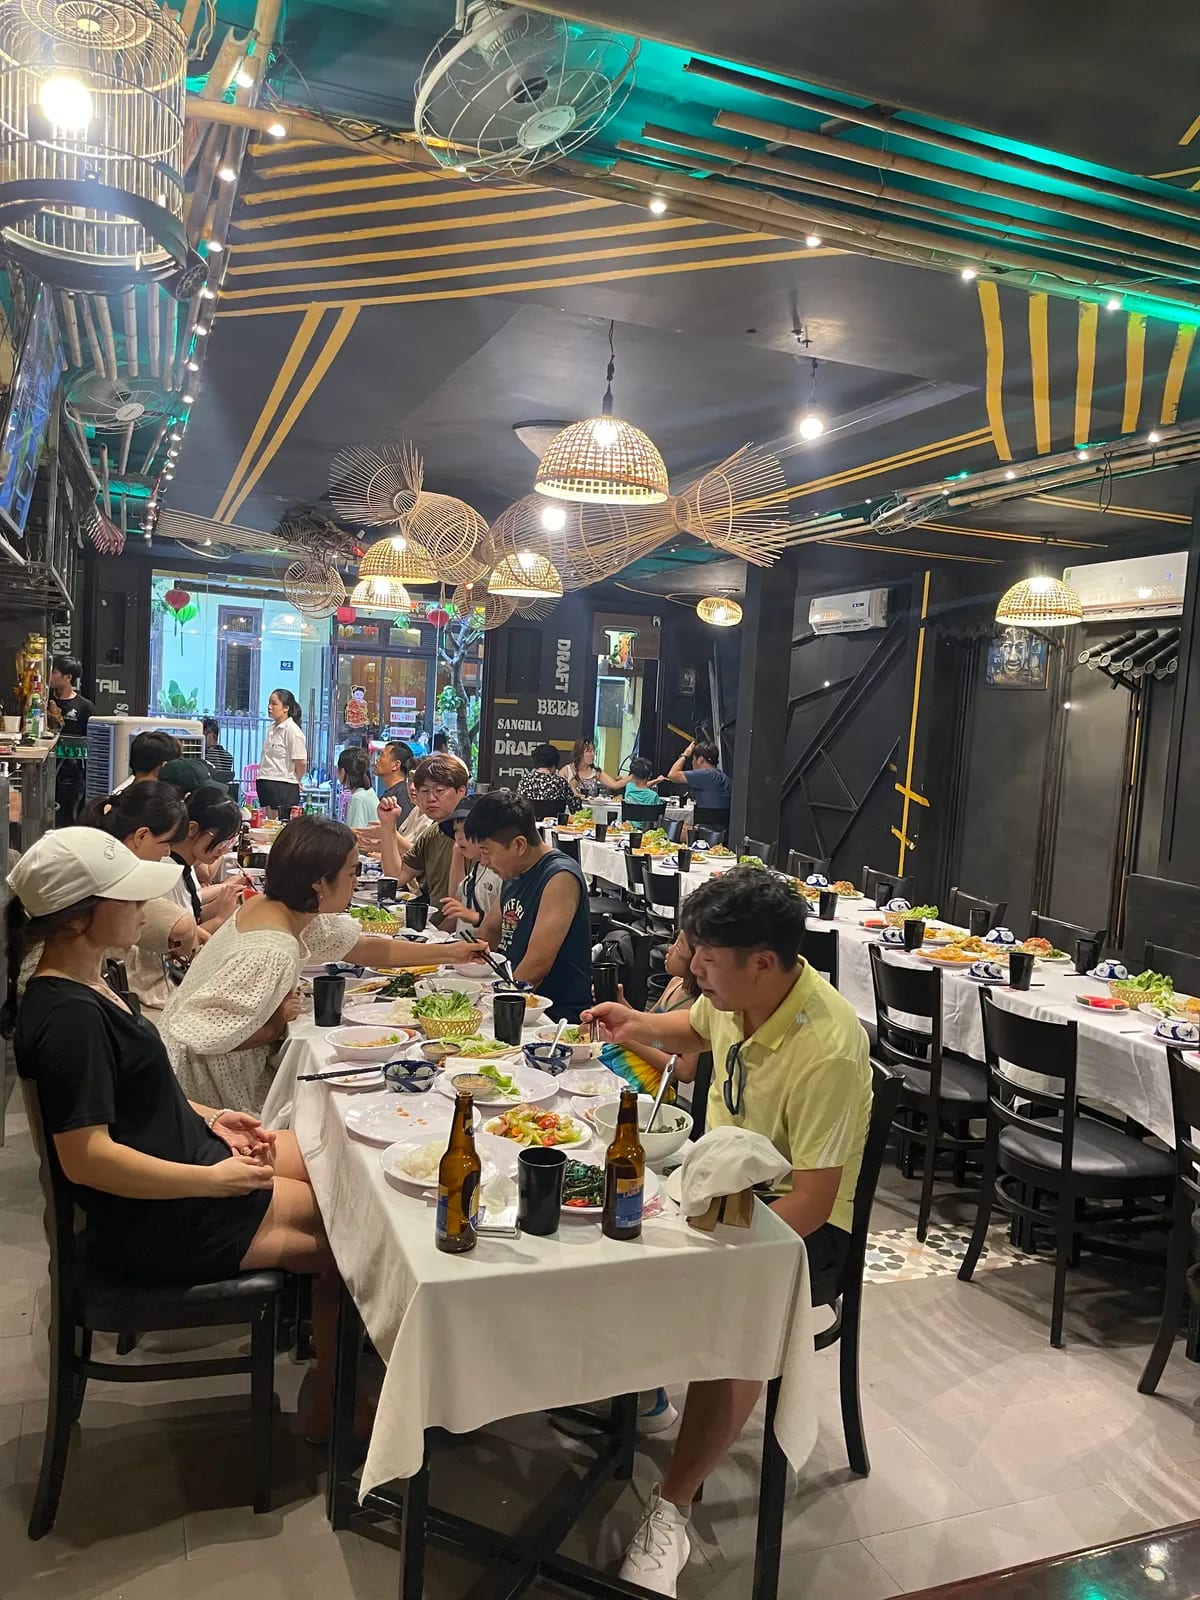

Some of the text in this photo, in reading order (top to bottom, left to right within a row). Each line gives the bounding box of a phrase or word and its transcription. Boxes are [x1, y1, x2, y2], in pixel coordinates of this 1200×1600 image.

[555, 639, 571, 693] DRAFT
[537, 699, 579, 717] BEER
[497, 718, 542, 731] SANGRIA
